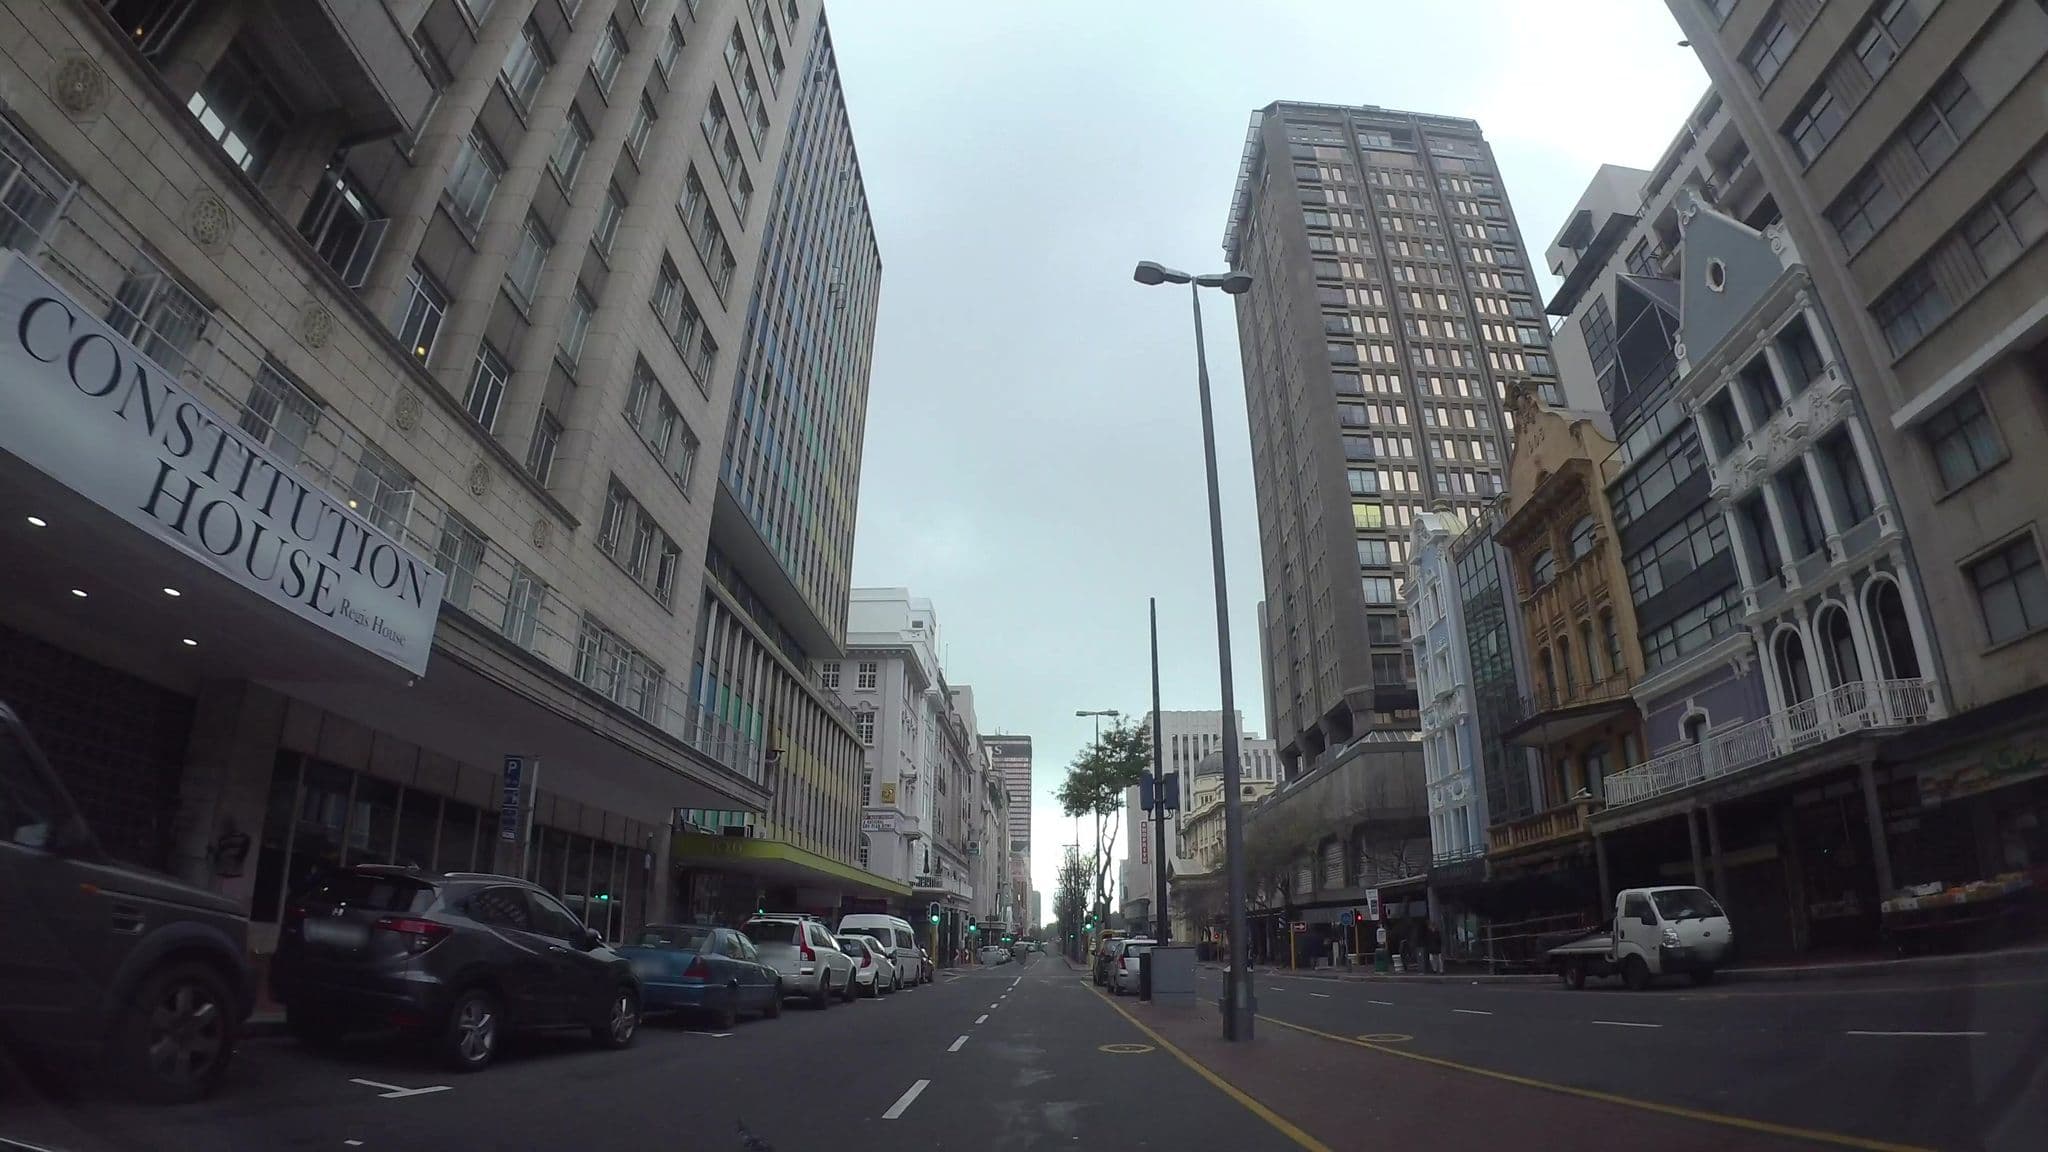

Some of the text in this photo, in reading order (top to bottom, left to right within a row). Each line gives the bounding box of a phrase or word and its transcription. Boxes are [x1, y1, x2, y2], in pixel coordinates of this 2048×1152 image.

[17, 297, 431, 609] CONSTITUTION
[138, 457, 341, 618] HOUSE
[340, 598, 407, 646] Regis House
[507, 760, 518, 774] P
